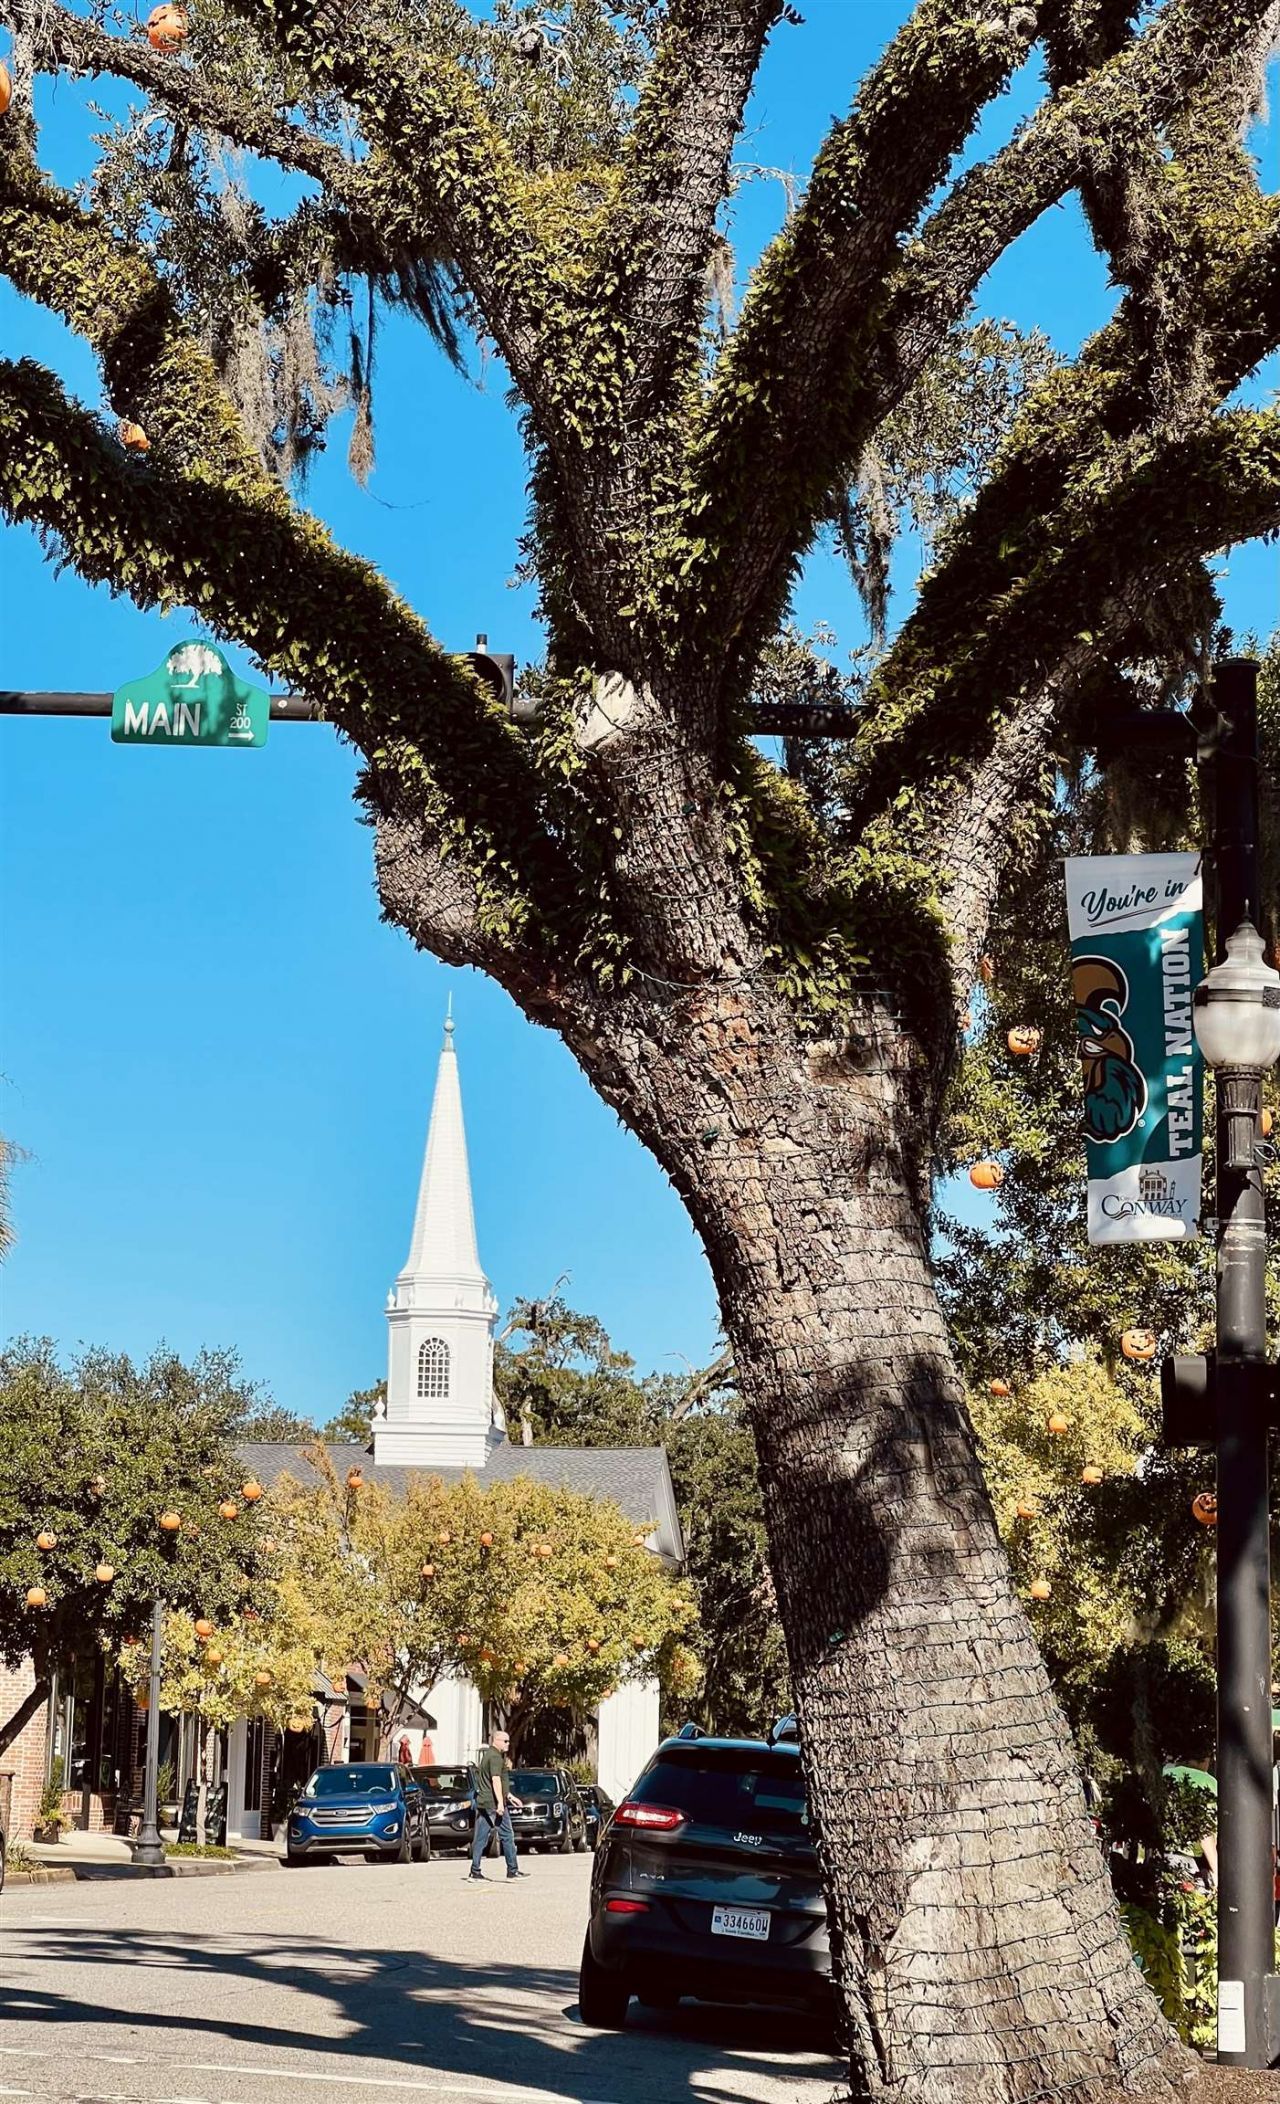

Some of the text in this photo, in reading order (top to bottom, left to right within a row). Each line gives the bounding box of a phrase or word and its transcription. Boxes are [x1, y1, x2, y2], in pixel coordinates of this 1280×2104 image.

[124, 701, 200, 736] MAIN
[236, 703, 248, 717] ST
[230, 717, 251, 729] 200
[1081, 879, 1189, 922] You're in
[1161, 928, 1193, 1157] TEAL NATION
[1101, 1194, 1187, 1217] CONWAY
[733, 1832, 762, 1846] Jeep
